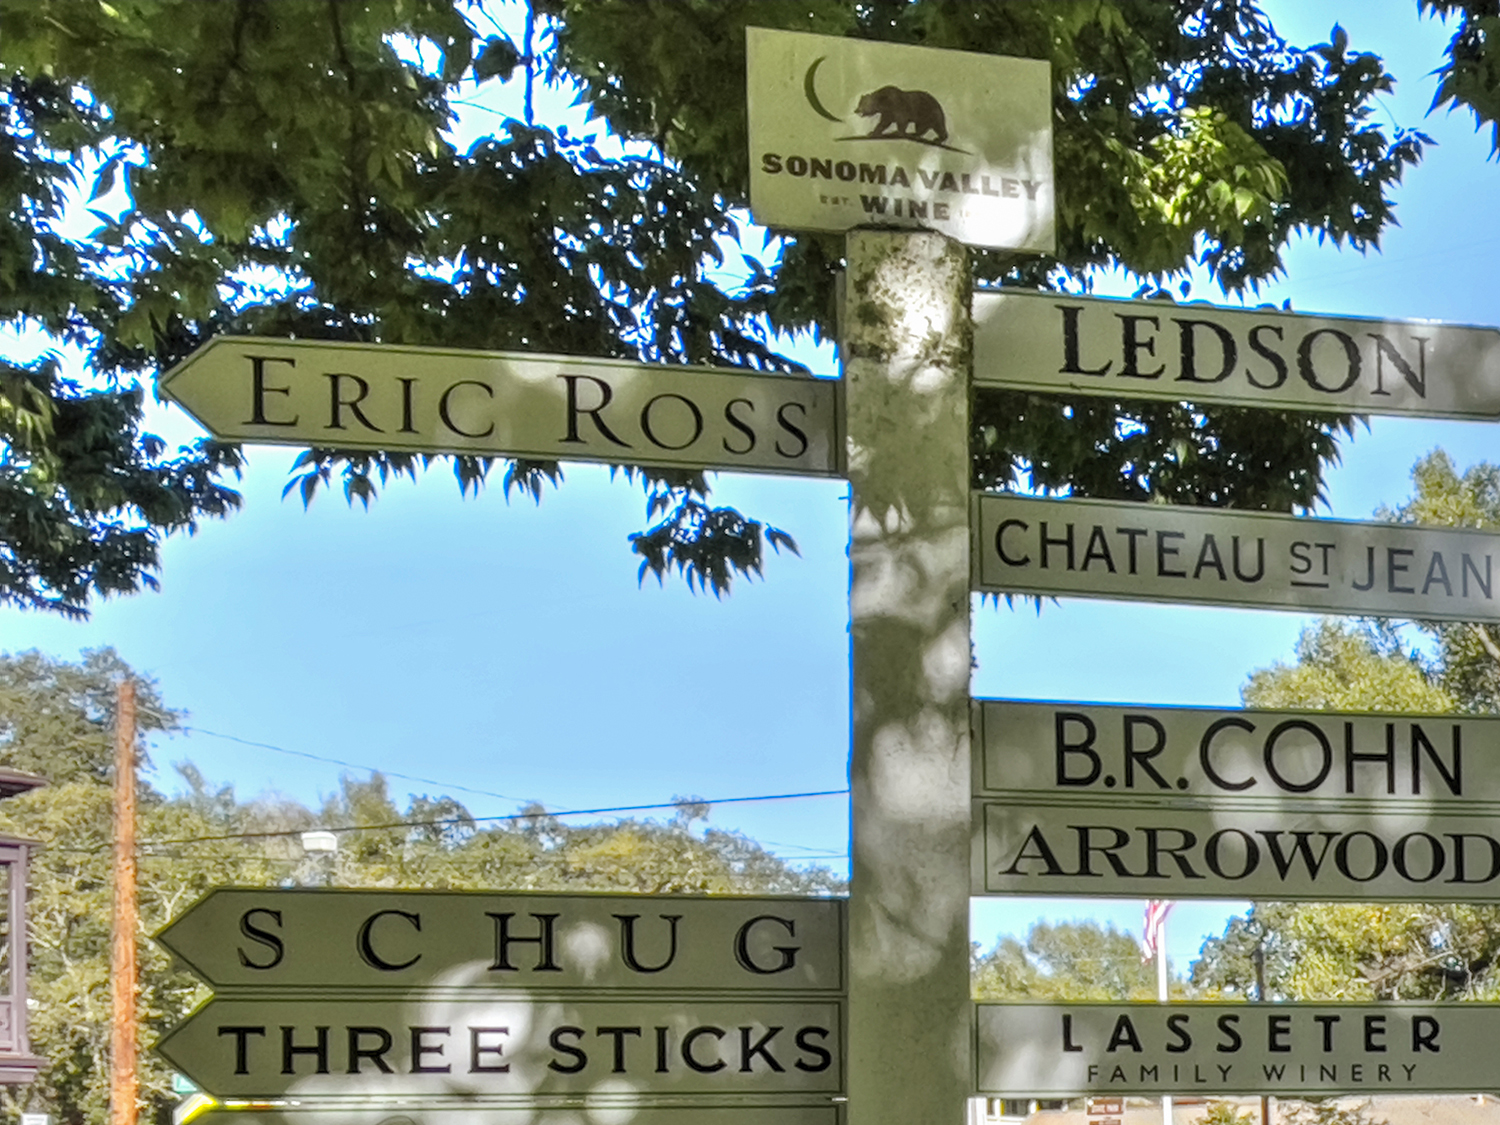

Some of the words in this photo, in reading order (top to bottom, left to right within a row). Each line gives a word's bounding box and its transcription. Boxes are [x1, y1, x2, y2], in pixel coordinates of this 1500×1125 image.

[761, 153, 911, 188] SONOMA
[917, 168, 1043, 201] VALLEY
[859, 194, 950, 221] WINE
[1054, 303, 1431, 399] LEDSON
[242, 354, 495, 439] ERIC
[557, 373, 810, 459] ROSS
[994, 518, 1266, 583] CHATEAU
[1289, 541, 1336, 580] ST
[1351, 545, 1494, 600] JEAN
[217, 1025, 510, 1076] THREE
[546, 1025, 833, 1075] STICKS
[1061, 1013, 1442, 1054] LASSETER
[1087, 1063, 1233, 1085] FAMILY
[1262, 1062, 1418, 1084] WINERY
